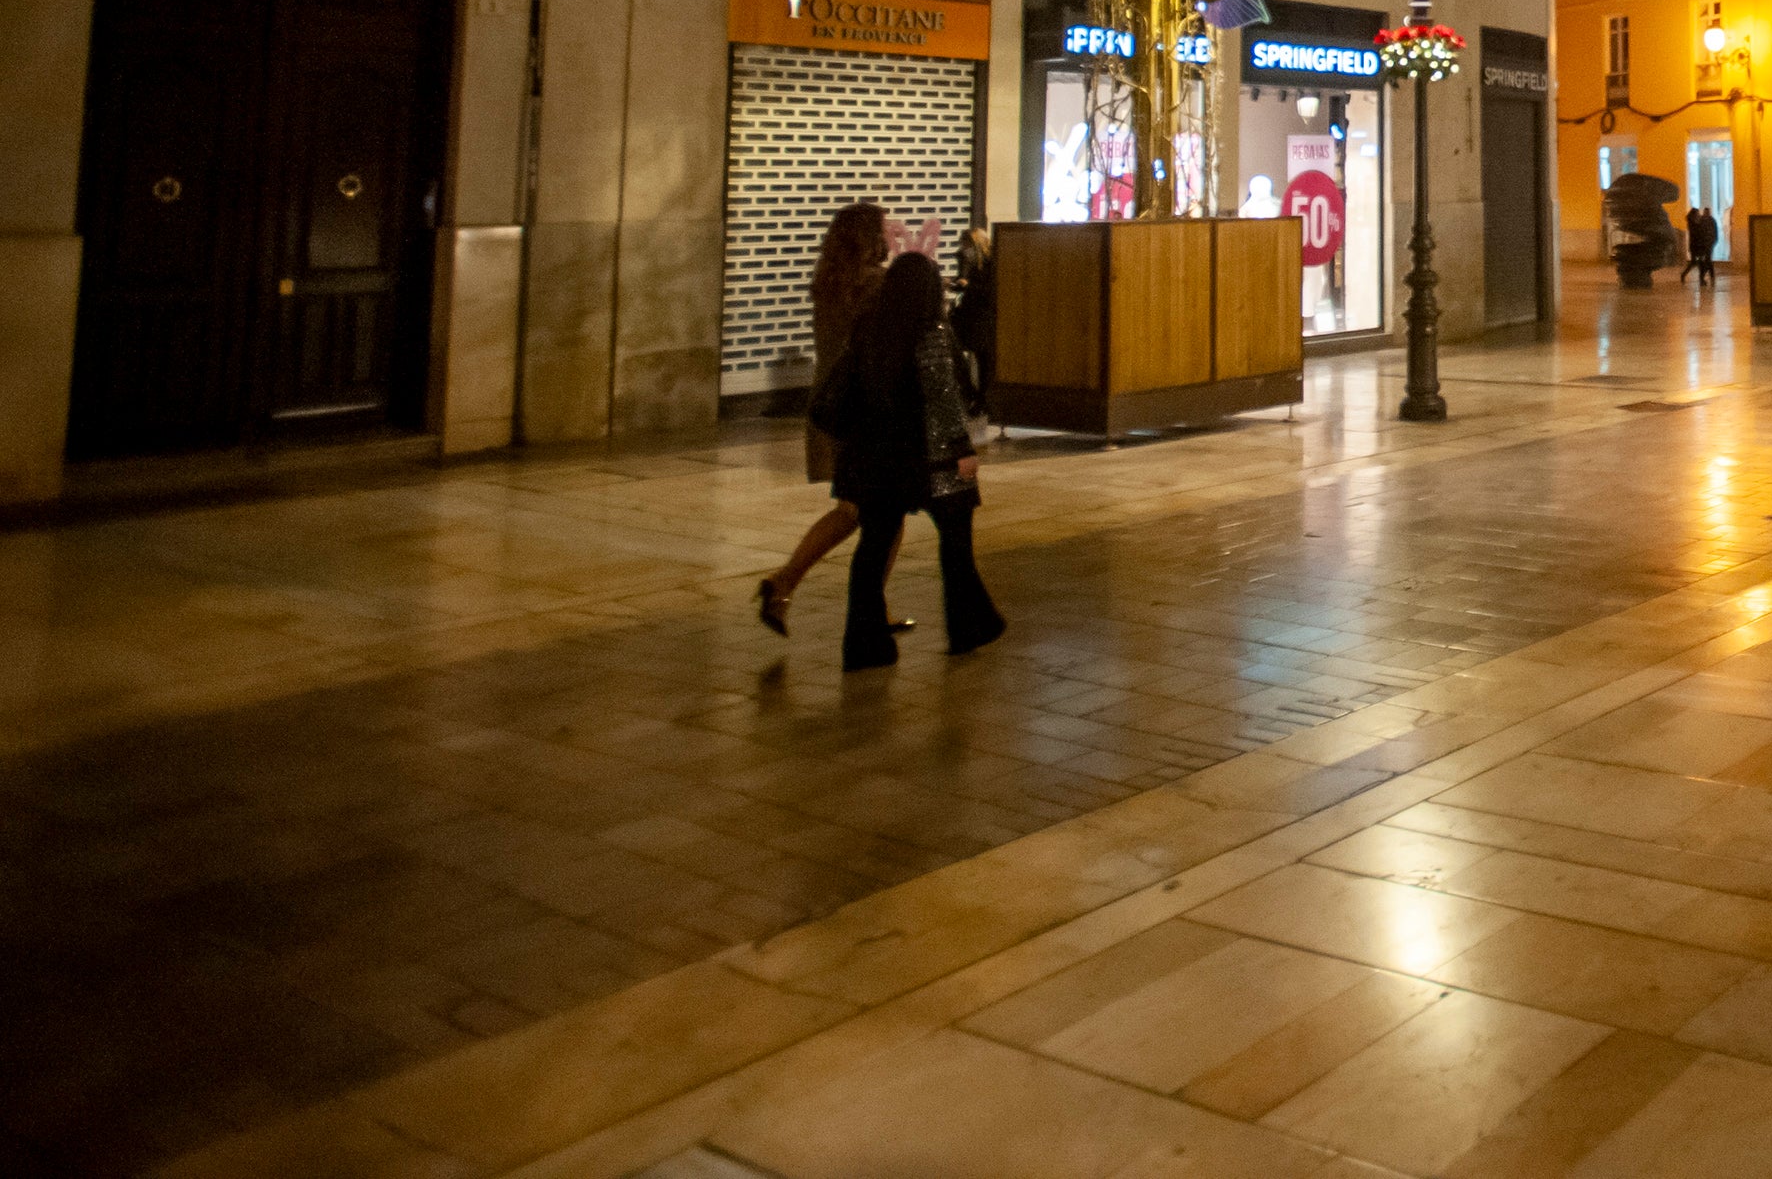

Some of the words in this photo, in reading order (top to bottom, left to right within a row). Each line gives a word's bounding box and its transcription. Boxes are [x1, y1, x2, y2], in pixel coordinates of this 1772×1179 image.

[812, 24, 835, 38] EN
[842, 26, 927, 45] PROVENCE
[1253, 42, 1378, 75] SPRINGFIELD
